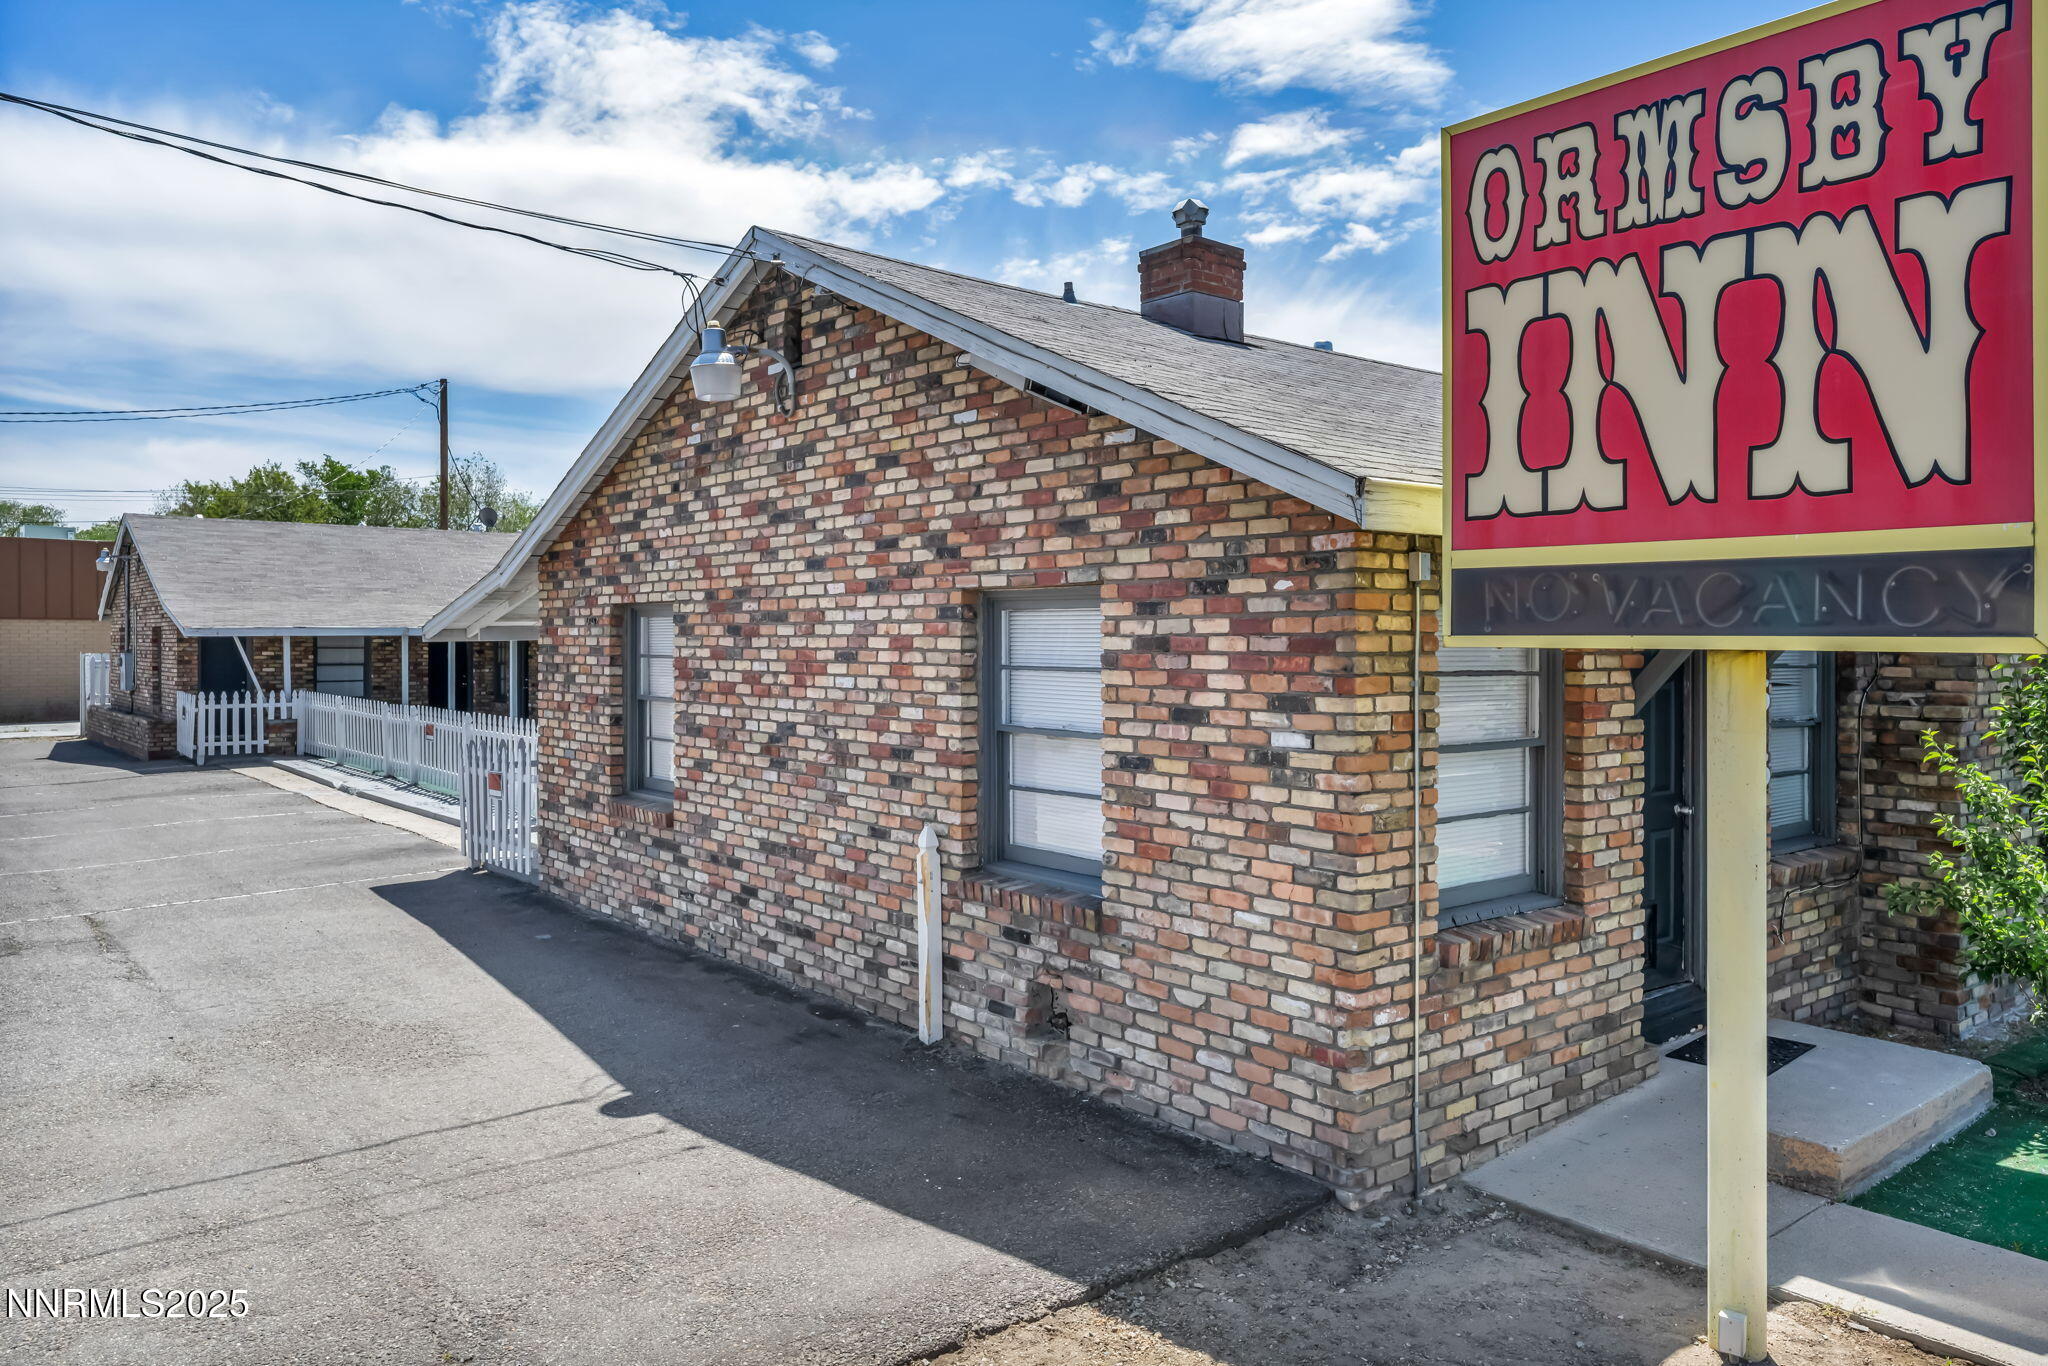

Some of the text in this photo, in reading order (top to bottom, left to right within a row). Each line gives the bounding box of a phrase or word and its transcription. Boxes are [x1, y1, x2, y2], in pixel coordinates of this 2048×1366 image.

[1465, 0, 2014, 265] ORMSBY
[1465, 175, 2014, 522] INN
[1484, 564, 2024, 630] NO VACANCY
